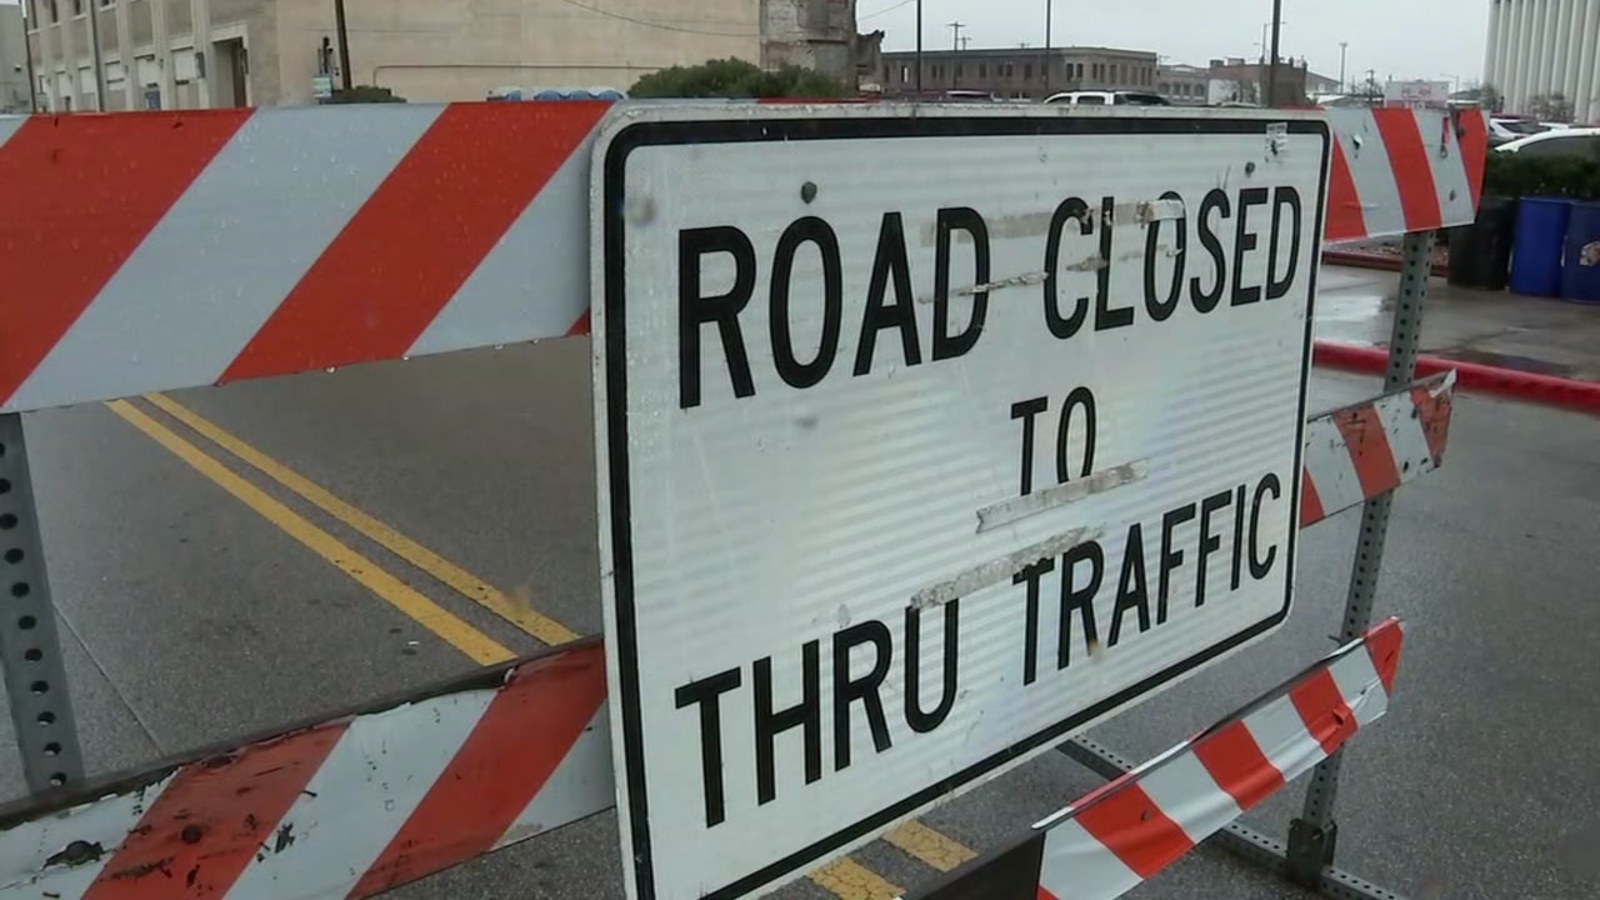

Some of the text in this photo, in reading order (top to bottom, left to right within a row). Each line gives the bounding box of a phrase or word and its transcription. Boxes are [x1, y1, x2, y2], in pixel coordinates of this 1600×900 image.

[678, 186, 1302, 409] ROAD CLOSED
[1011, 386, 1096, 496] TO
[673, 473, 1280, 829] THRU TRAFFIC
